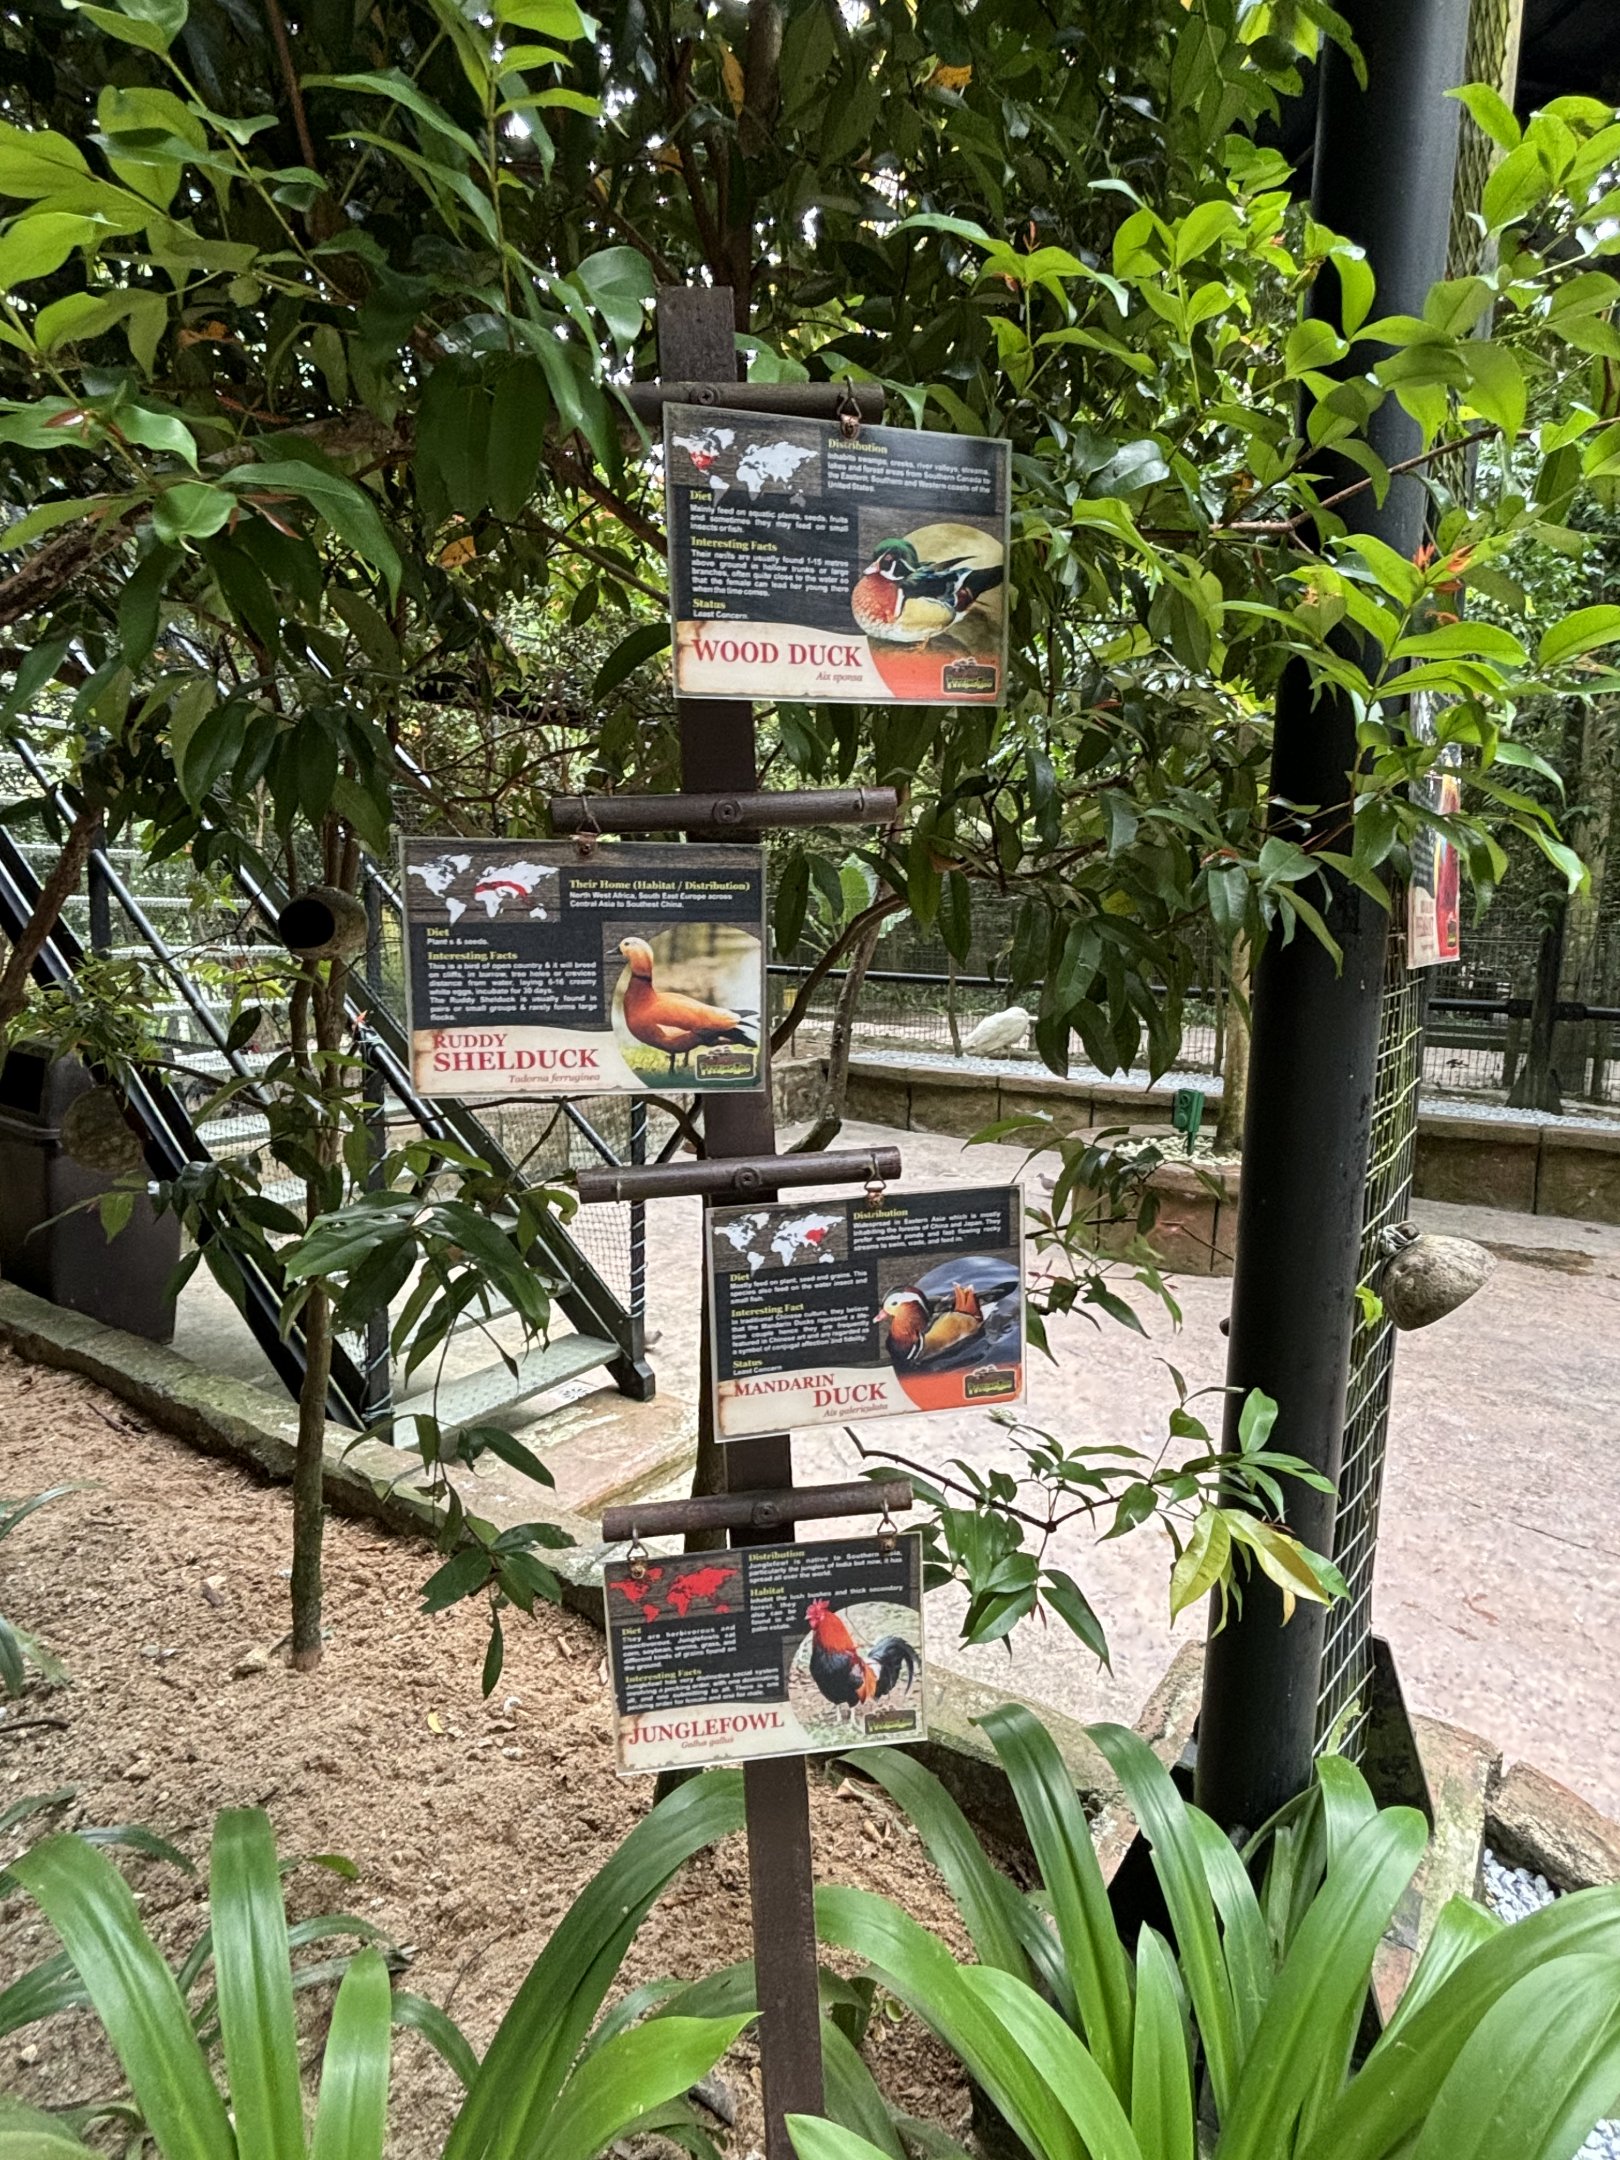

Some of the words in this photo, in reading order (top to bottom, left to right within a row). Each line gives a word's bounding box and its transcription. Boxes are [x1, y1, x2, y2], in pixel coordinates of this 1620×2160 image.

[828, 438, 887, 454] Distribution
[689, 489, 711, 501] Diet
[689, 513, 705, 521] and
[709, 514, 751, 524] sometimes
[755, 518, 771, 528] they
[775, 521, 791, 529] may
[795, 521, 811, 529] feed
[829, 524, 848, 532] small
[690, 535, 749, 551] Interesting
[751, 540, 777, 551] Facts
[691, 549, 711, 557] Their
[753, 553, 779, 564] usually
[782, 555, 804, 564] found
[824, 558, 848, 567] metres
[691, 558, 715, 566] above
[719, 560, 747, 570] ground
[762, 563, 787, 571] hollow
[791, 565, 814, 573] trunks
[831, 568, 849, 577] large
[692, 576, 707, 584] that
[710, 577, 723, 585] the
[726, 578, 751, 586] female
[805, 584, 828, 592] young
[692, 598, 726, 609] Status
[691, 638, 779, 664] WOOD
[788, 643, 862, 667] DUCK
[815, 671, 830, 681] Aix
[832, 673, 863, 683] sponsa
[569, 880, 597, 888] Their
[599, 880, 631, 889] Home
[632, 880, 675, 890] (Habitat
[676, 881, 683, 891] /
[685, 880, 750, 891] Distribution)
[569, 899, 596, 907] Central
[680, 893, 705, 901] Europe
[426, 927, 449, 936] Diet
[427, 951, 488, 961] Interesting
[489, 951, 518, 959] Facts
[513, 962, 542, 970] country
[449, 996, 475, 1004] Ruddy
[531, 995, 559, 1003] usually
[432, 1033, 508, 1048] RUDDY
[432, 1048, 599, 1072] SHELDUCK
[508, 1074, 549, 1083] Tadorna
[550, 1072, 600, 1083] ferruginea
[853, 1207, 908, 1220] Distribution
[729, 1272, 750, 1282] Diet
[730, 1304, 783, 1318] Interesting
[784, 1302, 804, 1311] Fact
[732, 1358, 762, 1369] Status
[733, 1372, 834, 1397] MANDARIN
[813, 1381, 887, 1408] DUCK
[822, 1408, 837, 1417] Aix
[838, 1401, 888, 1417] galericulata
[748, 1548, 805, 1562] Distribution
[749, 1585, 785, 1597] Habitat
[621, 1626, 641, 1636] Diet
[624, 1670, 676, 1684] Interesting
[677, 1667, 702, 1677] Facts
[627, 1710, 784, 1745] JUNGLEFOWL
